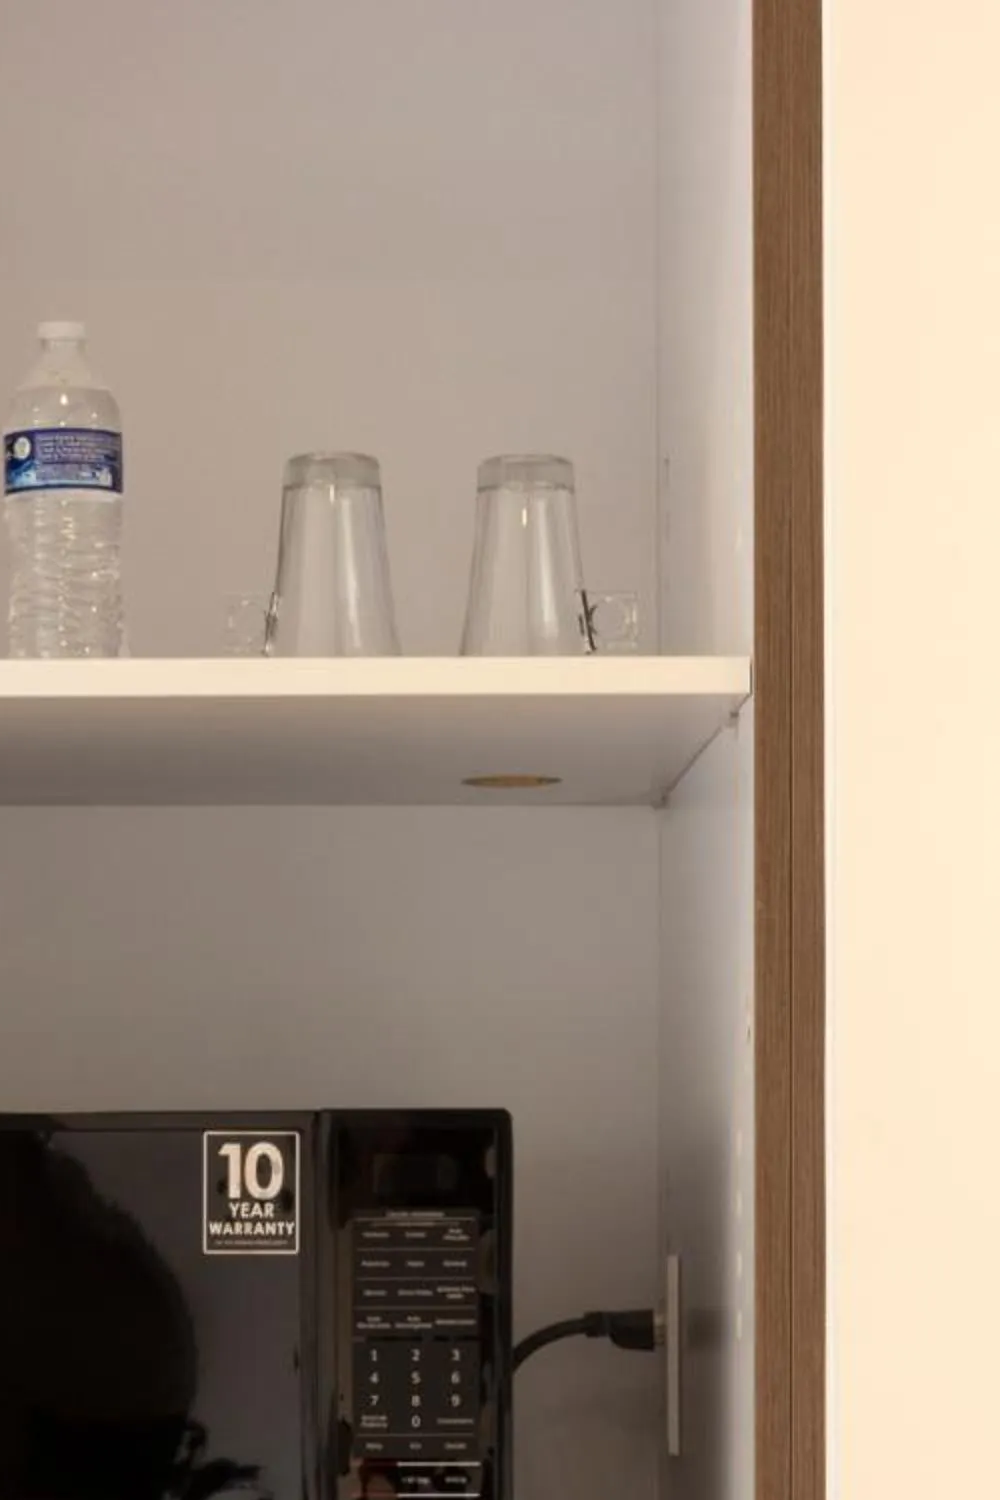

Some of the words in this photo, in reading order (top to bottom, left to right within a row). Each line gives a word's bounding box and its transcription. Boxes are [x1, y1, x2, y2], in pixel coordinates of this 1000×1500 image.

[218, 1141, 284, 1200] 10
[229, 1202, 275, 1218] YEAR
[209, 1221, 295, 1236] WARRANTY
[369, 1348, 378, 1362] 1
[411, 1348, 421, 1362] 2
[451, 1348, 461, 1362] 3
[369, 1371, 380, 1384] 4
[411, 1371, 421, 1385] 5
[451, 1371, 461, 1384] 6
[369, 1394, 379, 1406] 7
[411, 1394, 421, 1407] 8
[451, 1394, 461, 1407] 9
[411, 1414, 421, 1428] 0
